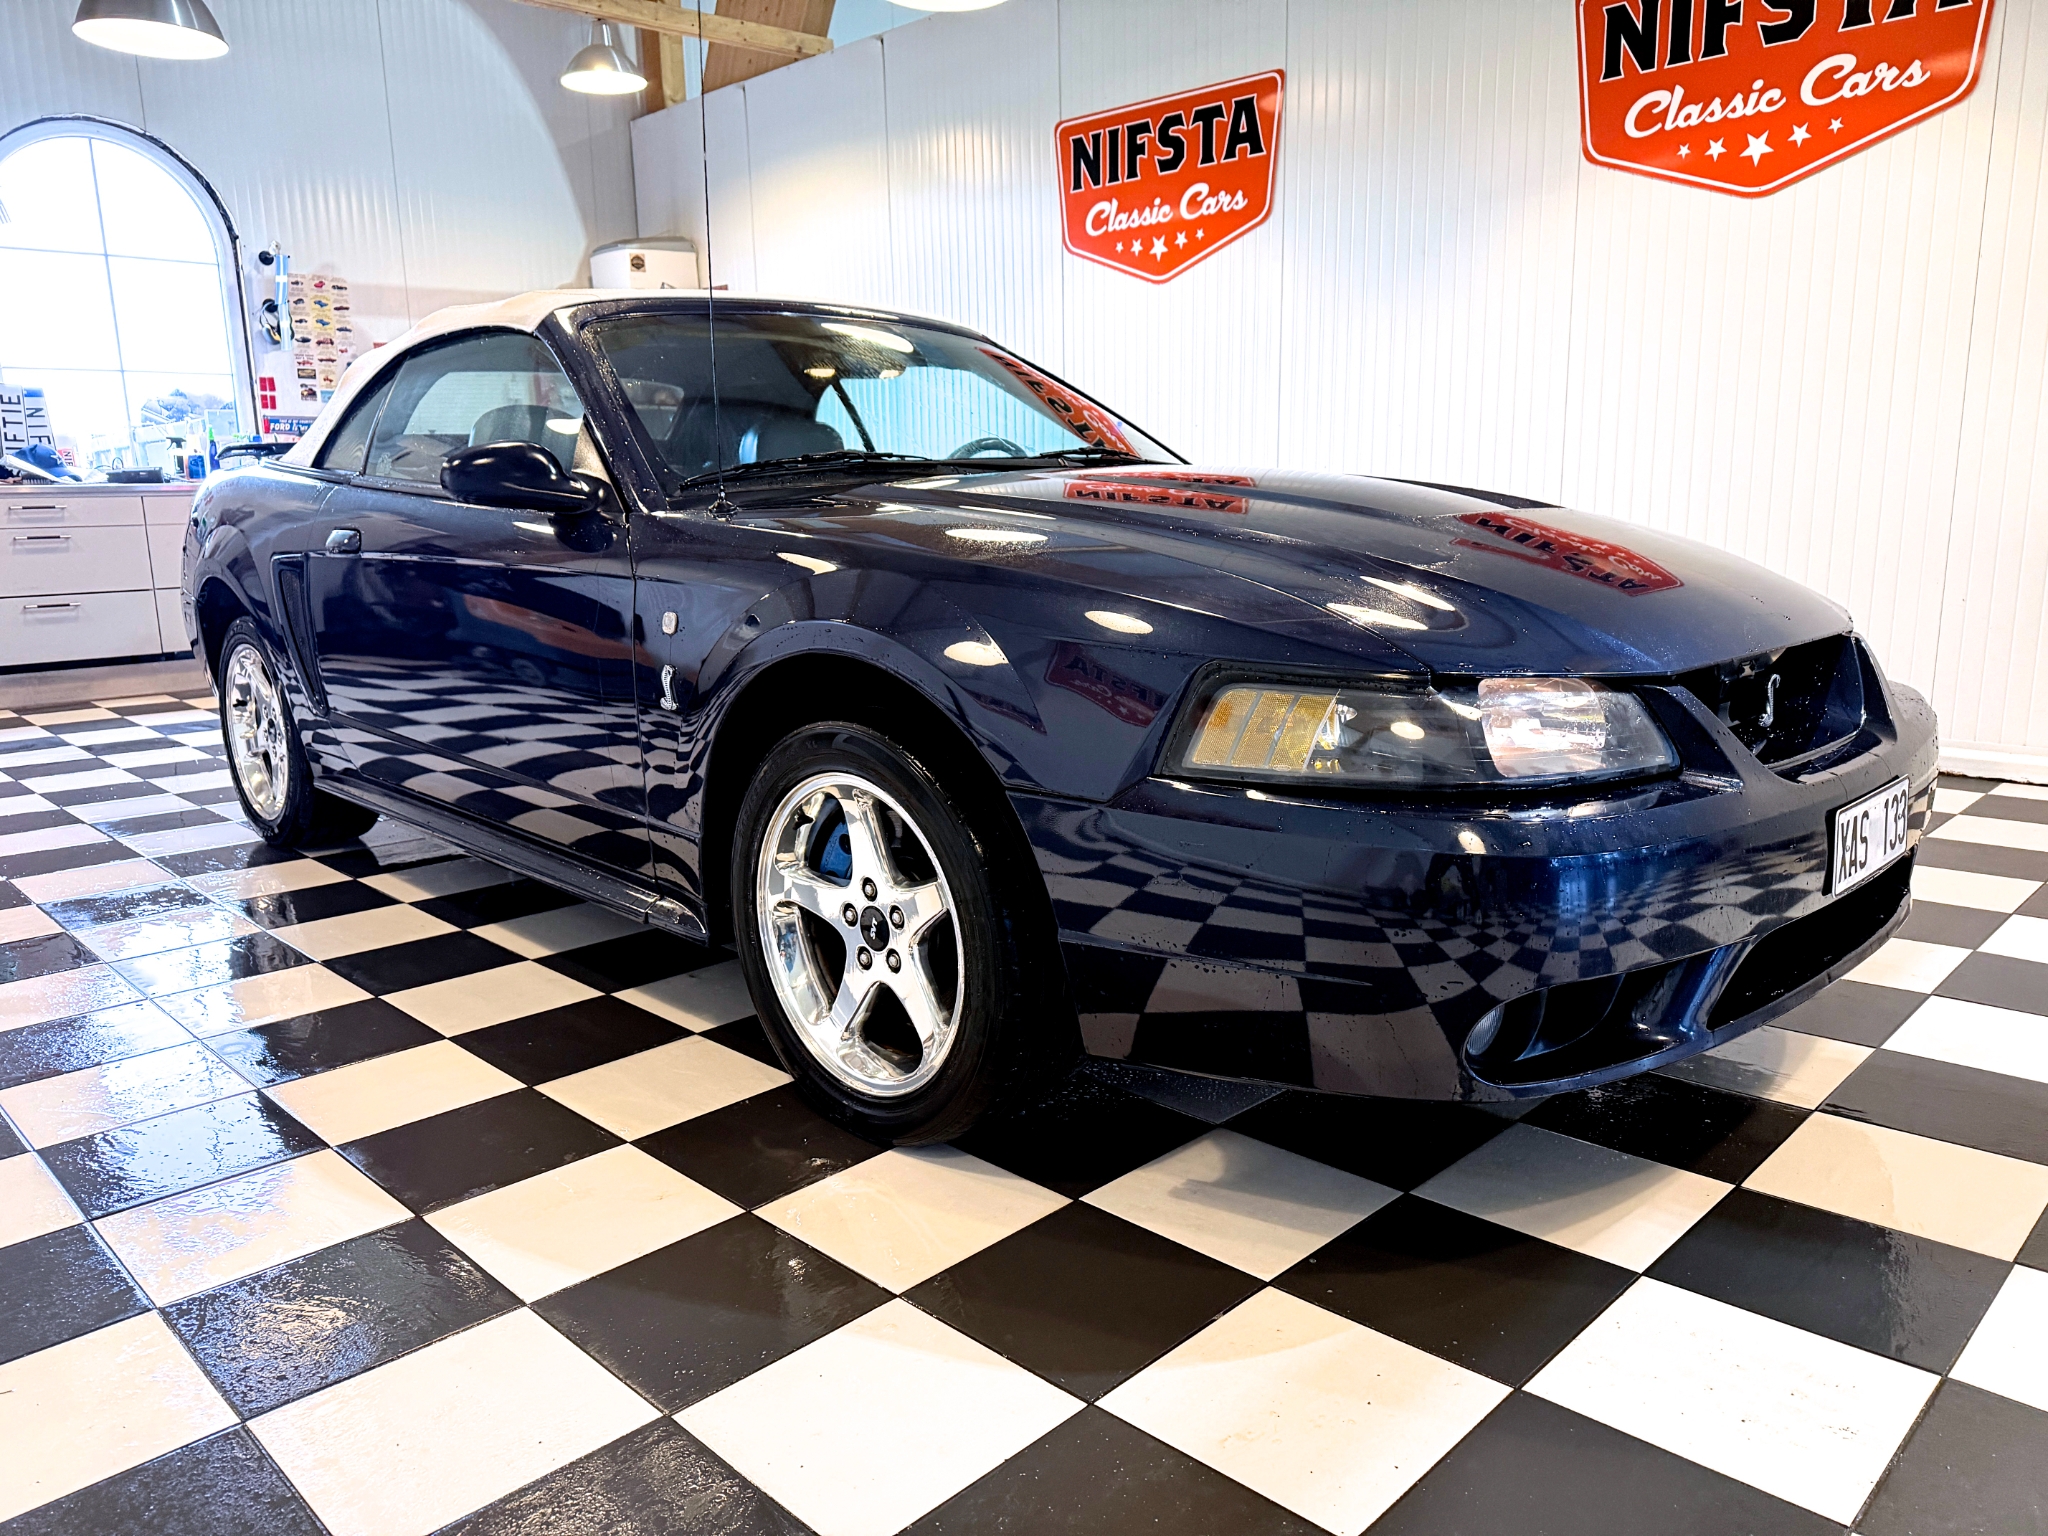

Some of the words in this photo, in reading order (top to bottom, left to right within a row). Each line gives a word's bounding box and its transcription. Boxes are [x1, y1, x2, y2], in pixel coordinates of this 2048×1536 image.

[1599, 0, 1974, 83] NIF
[1624, 78, 1786, 138] Classic
[1799, 53, 1931, 107] Cars
[1069, 93, 1267, 194] NIFSTA
[1085, 197, 1173, 237] Classic
[1179, 182, 1249, 220] Cars
[270, 422, 290, 431] FORD
[1837, 809, 1870, 884] XAS
[1882, 788, 1909, 856] 133
